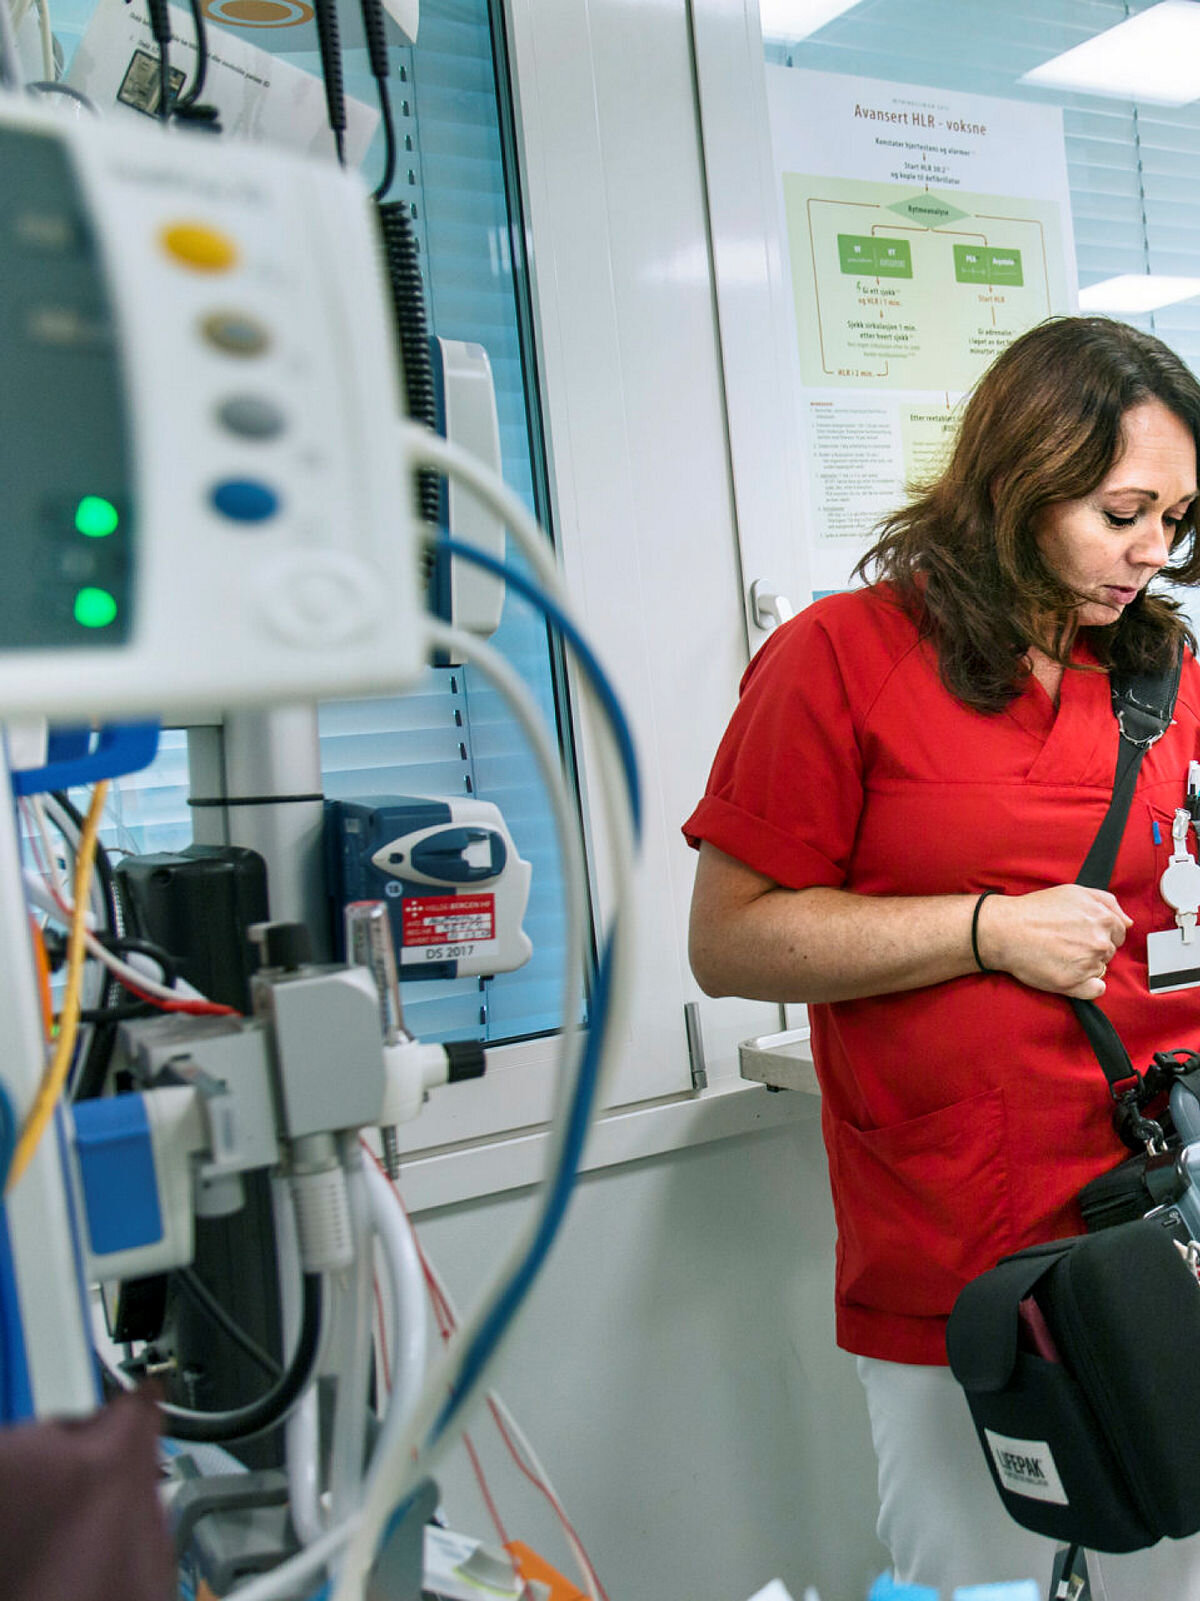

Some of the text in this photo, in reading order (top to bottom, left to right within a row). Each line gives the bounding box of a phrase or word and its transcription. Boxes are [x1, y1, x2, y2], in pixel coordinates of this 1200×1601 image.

[854, 103, 908, 126] Avansert
[912, 112, 935, 129] HLR
[946, 118, 987, 136] voksne
[426, 945, 474, 960] DS 2017
[997, 1448, 1045, 1479] LIFEPAK
